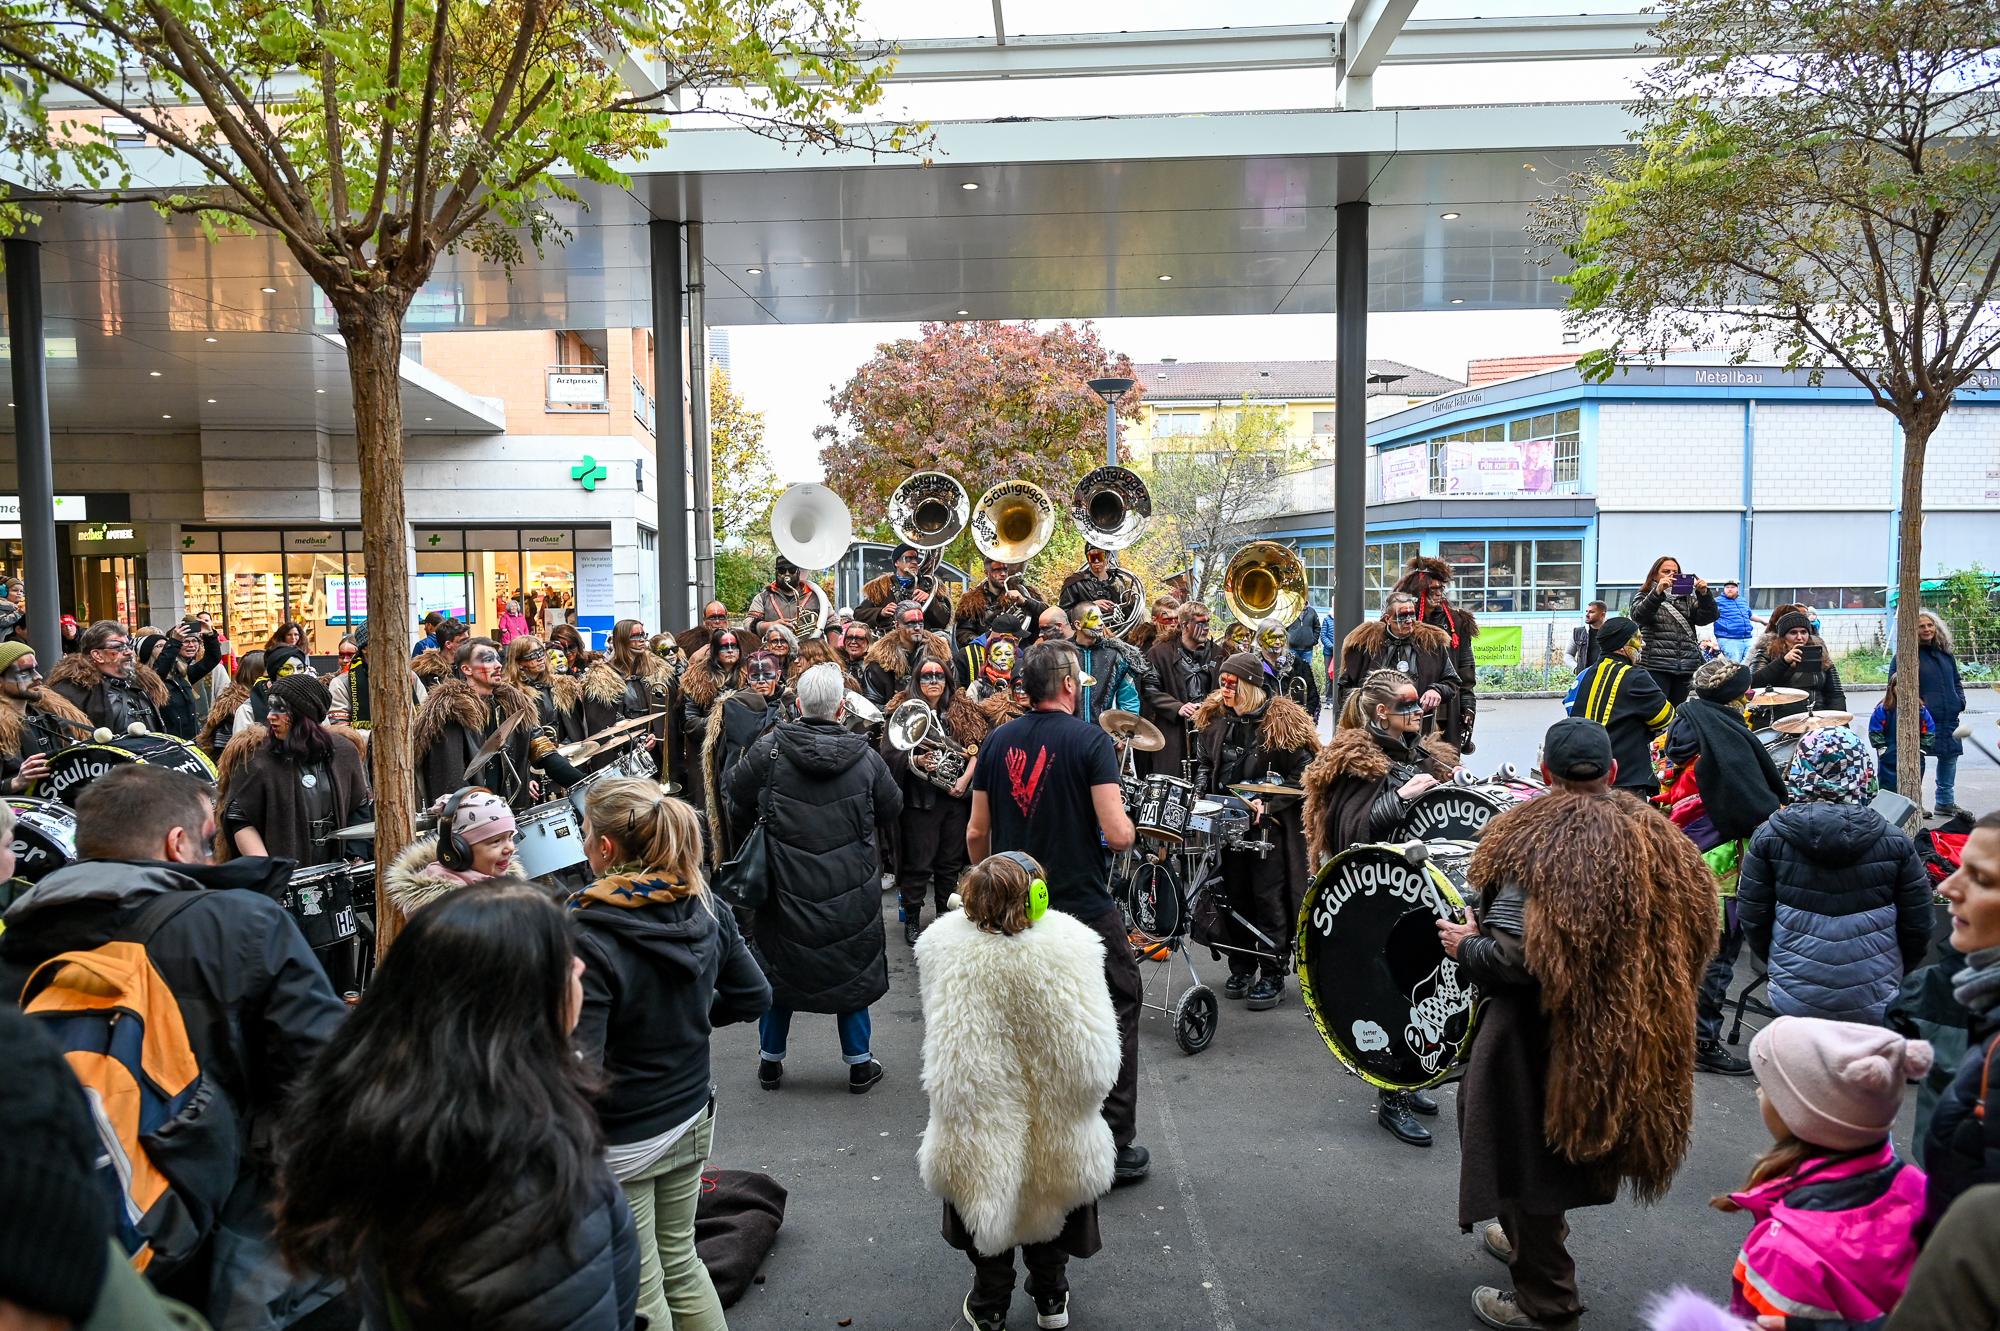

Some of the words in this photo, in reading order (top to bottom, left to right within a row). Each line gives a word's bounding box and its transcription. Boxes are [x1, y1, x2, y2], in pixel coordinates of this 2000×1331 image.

[556, 377, 598, 385] Arztpraxis
[1695, 370, 1764, 384] Metallbau
[1480, 460, 1493, 470] FÜR
[895, 474, 964, 504] Säuligugger
[983, 481, 1051, 513] Säuligugger
[350, 671, 360, 722] Guggenmusik
[1313, 862, 1453, 936] Säuligugger
